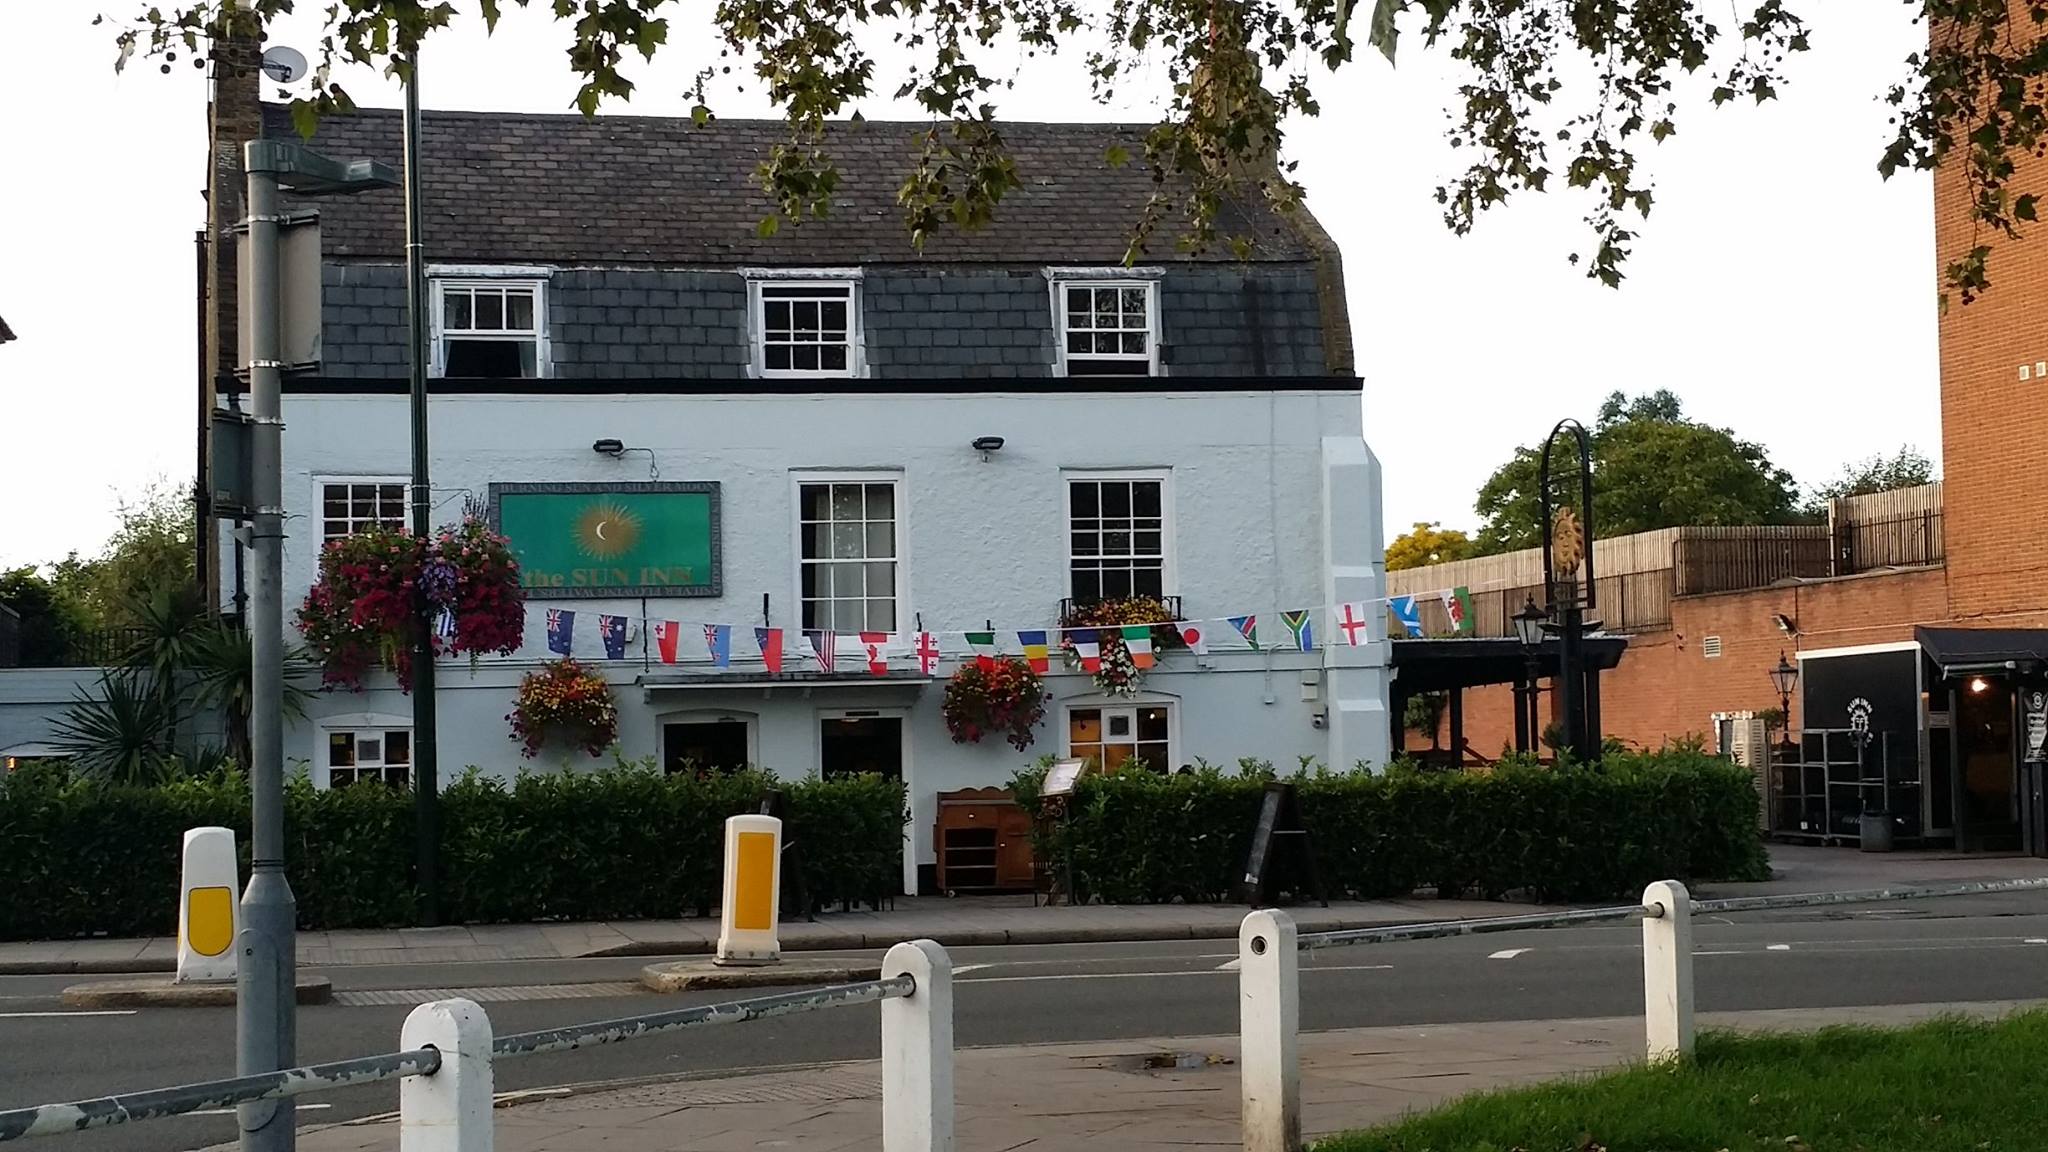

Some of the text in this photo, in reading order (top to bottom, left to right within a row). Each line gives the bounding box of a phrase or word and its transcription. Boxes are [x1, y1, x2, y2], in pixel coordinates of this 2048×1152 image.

[500, 482, 714, 493] BURNING SUN AND SILVER MOON
[525, 566, 693, 587] the SUN INN
[712, 562, 721, 594] GOLD
[598, 587, 662, 597] FLOWING
[665, 587, 712, 596] SILVER
[1847, 697, 1873, 714] SUN INN
